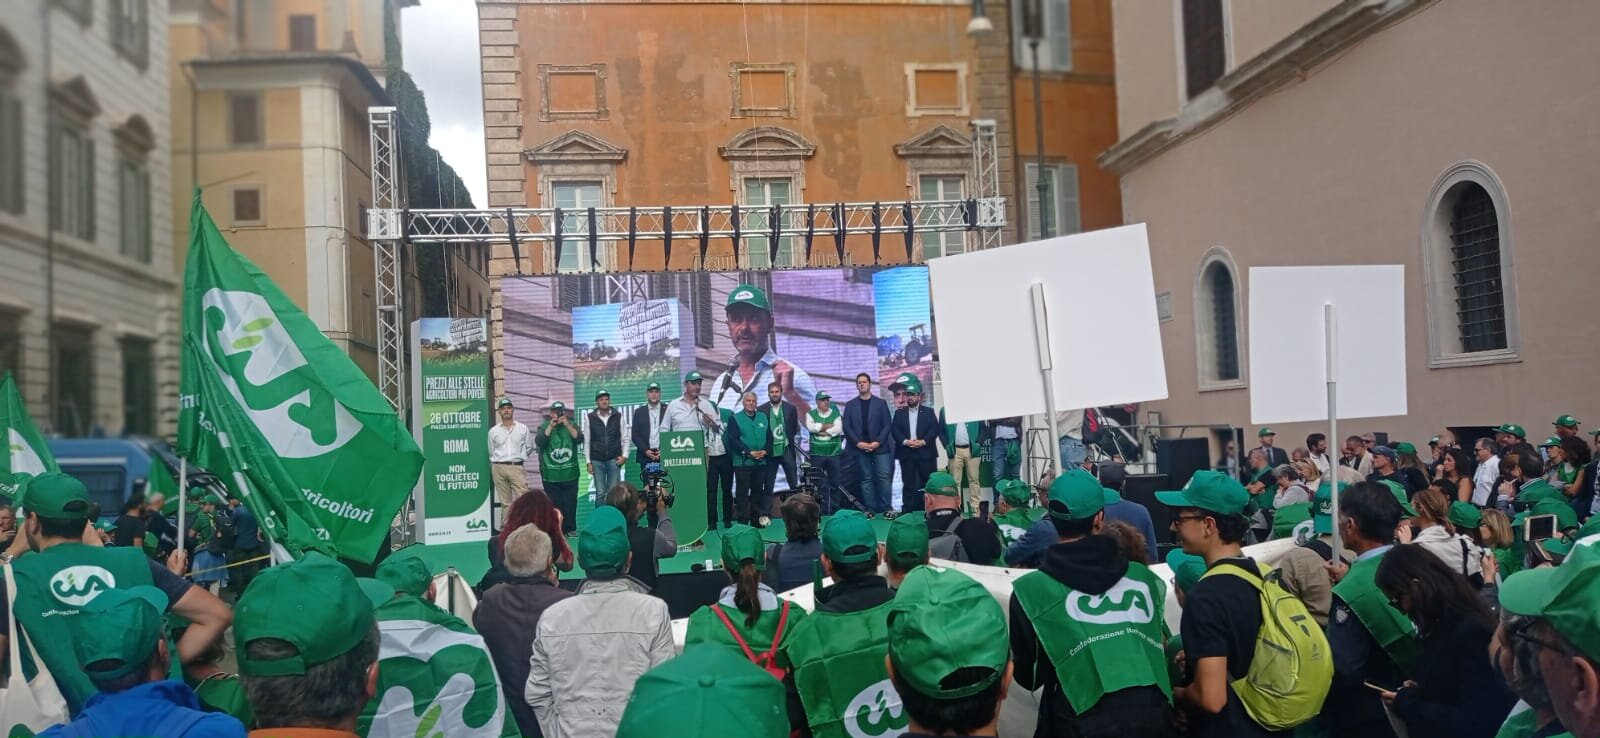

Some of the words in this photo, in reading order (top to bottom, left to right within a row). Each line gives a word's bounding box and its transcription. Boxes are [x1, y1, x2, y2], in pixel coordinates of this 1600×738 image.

[426, 377, 447, 389] PREZZI
[448, 377, 462, 389] ALLE
[464, 376, 484, 389] STELLE
[430, 412, 441, 424] 26
[443, 411, 481, 423] OTTOBRE
[443, 439, 470, 453] ROMA
[449, 464, 466, 473] NON
[435, 472, 479, 482] TOGLIETECI
[448, 481, 478, 490] FUTURO
[301, 488, 374, 523] ricoltori
